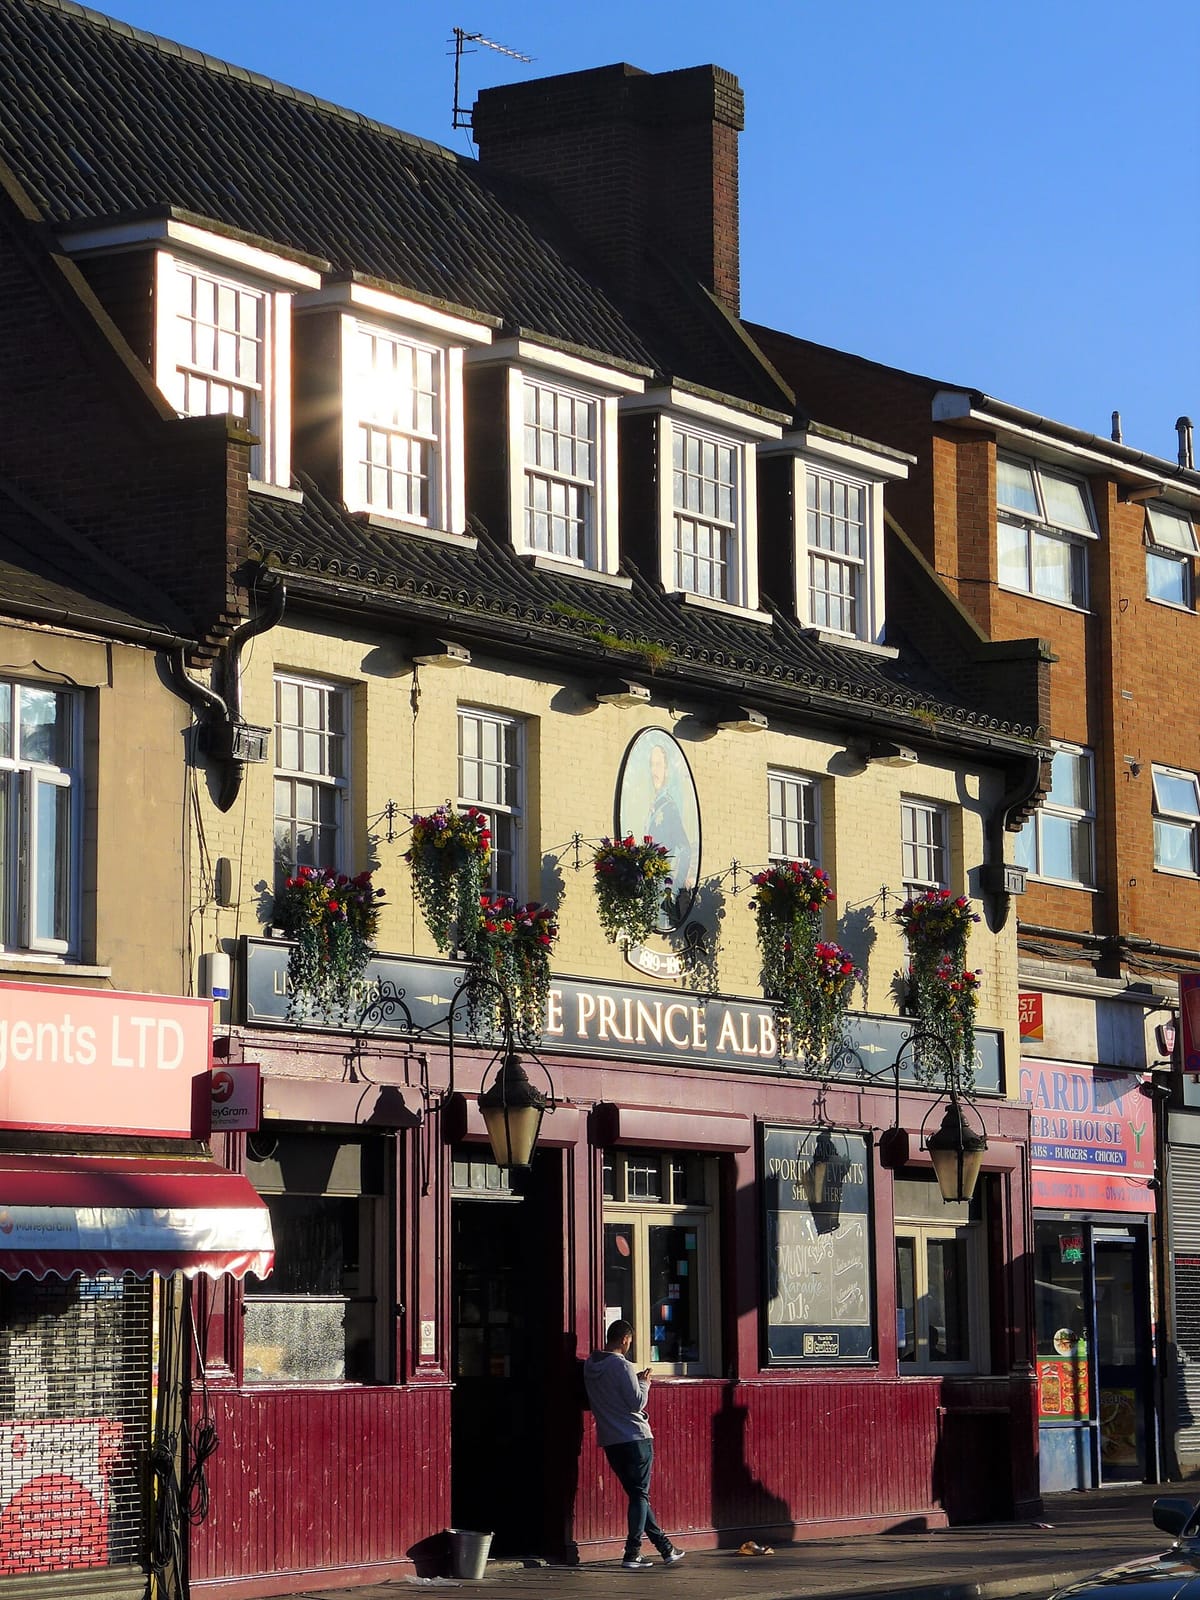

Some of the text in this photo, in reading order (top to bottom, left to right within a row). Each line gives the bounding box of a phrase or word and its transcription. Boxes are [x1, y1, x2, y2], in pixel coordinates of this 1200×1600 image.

[1018, 998, 1037, 1010] ST
[576, 992, 707, 1051] PRINCE
[1018, 1011, 1037, 1023] AT
[0, 1013, 185, 1072] ents LTD
[1019, 1068, 1125, 1117] GARDEN
[212, 1106, 248, 1119] eyGram
[1031, 1115, 1122, 1145] EBAB HOUSE
[1031, 1144, 1124, 1164] ABS BURGERS CHICKEN
[769, 1158, 820, 1183] SPORTIN
